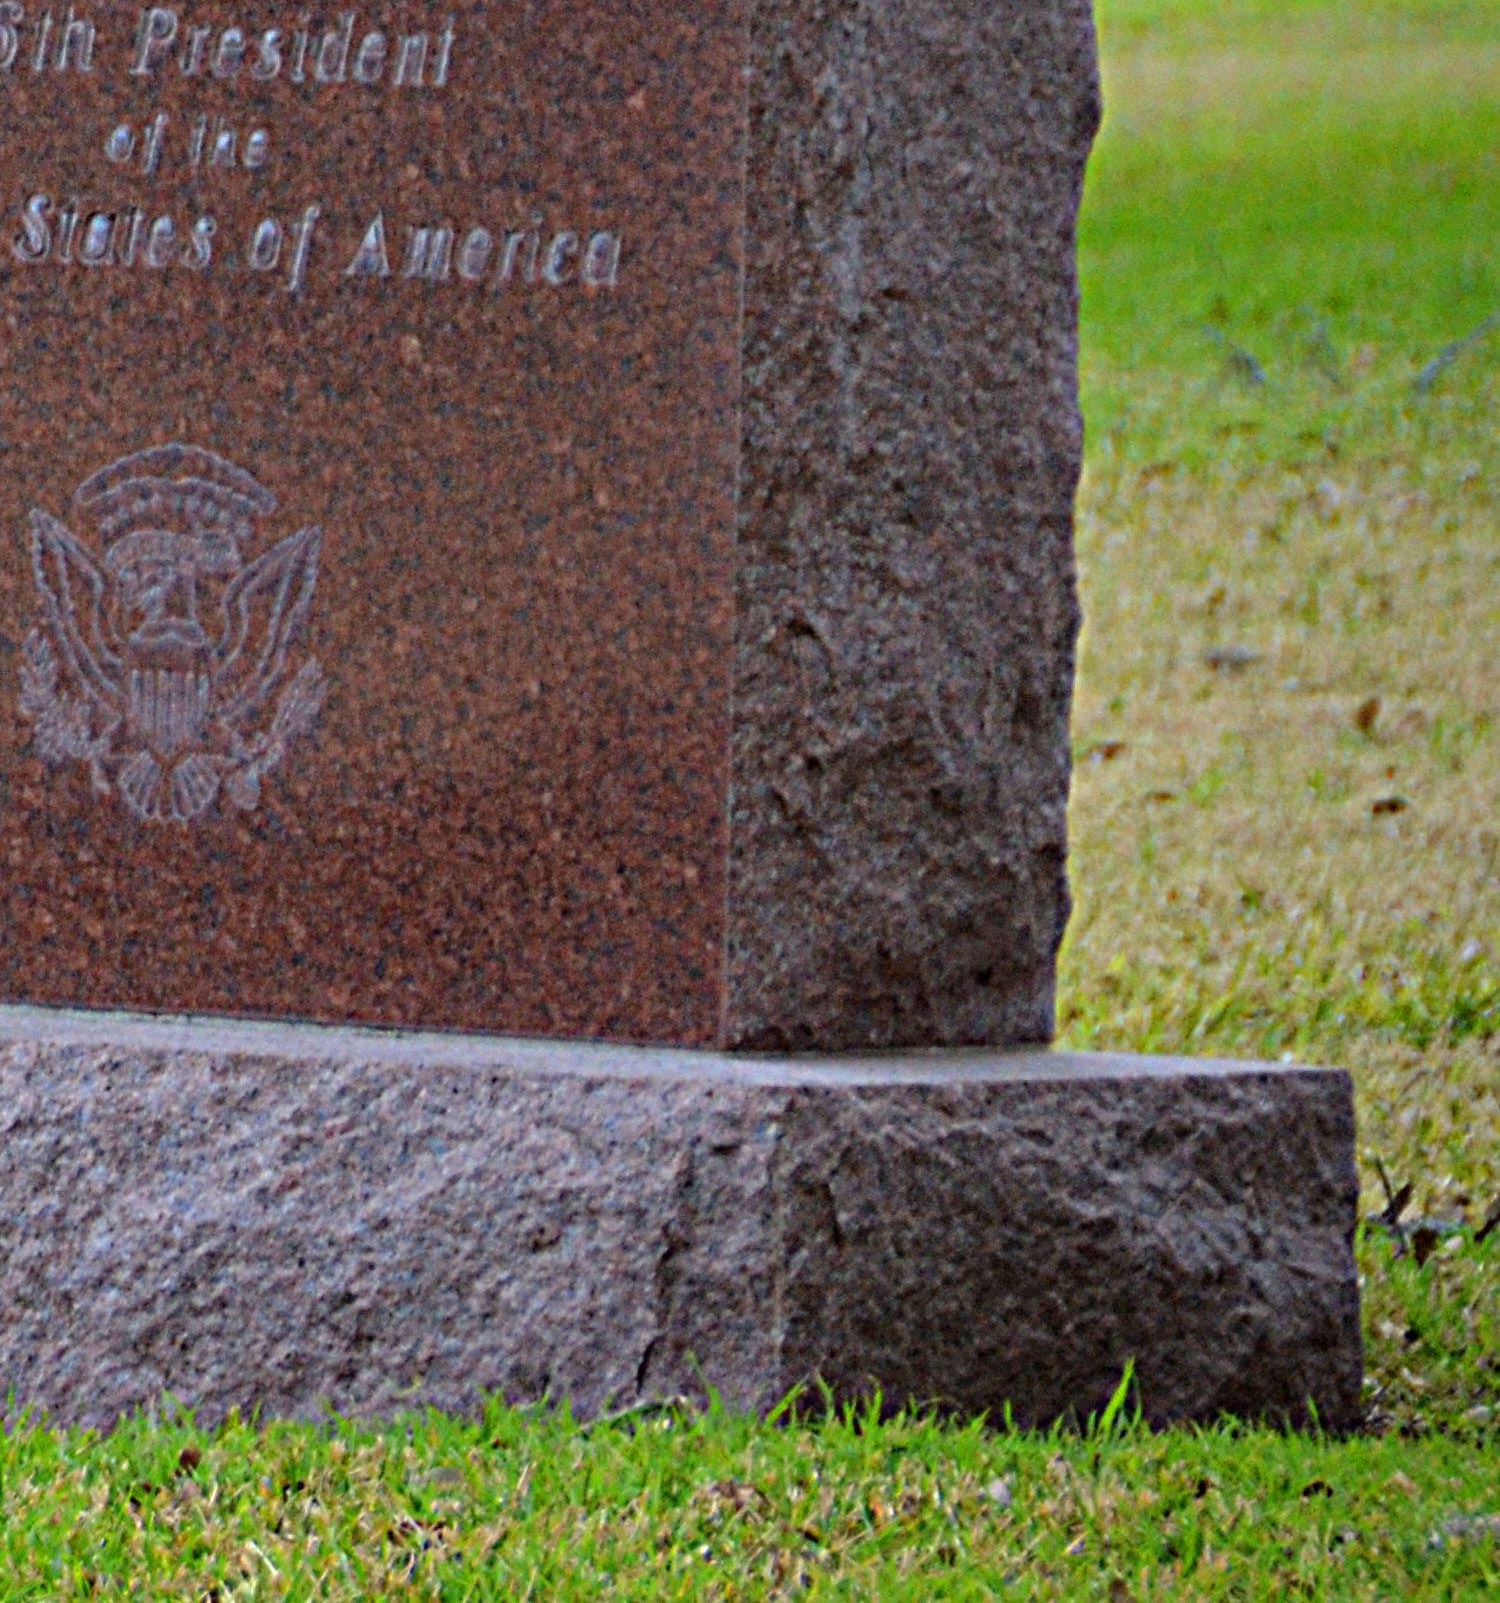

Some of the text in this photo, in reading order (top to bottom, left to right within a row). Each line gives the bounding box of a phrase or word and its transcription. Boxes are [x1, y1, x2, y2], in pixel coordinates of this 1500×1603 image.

[129, 6, 456, 87] President
[103, 111, 271, 176] of the
[13, 192, 219, 270] States
[249, 203, 321, 292] of
[344, 210, 622, 286] America
